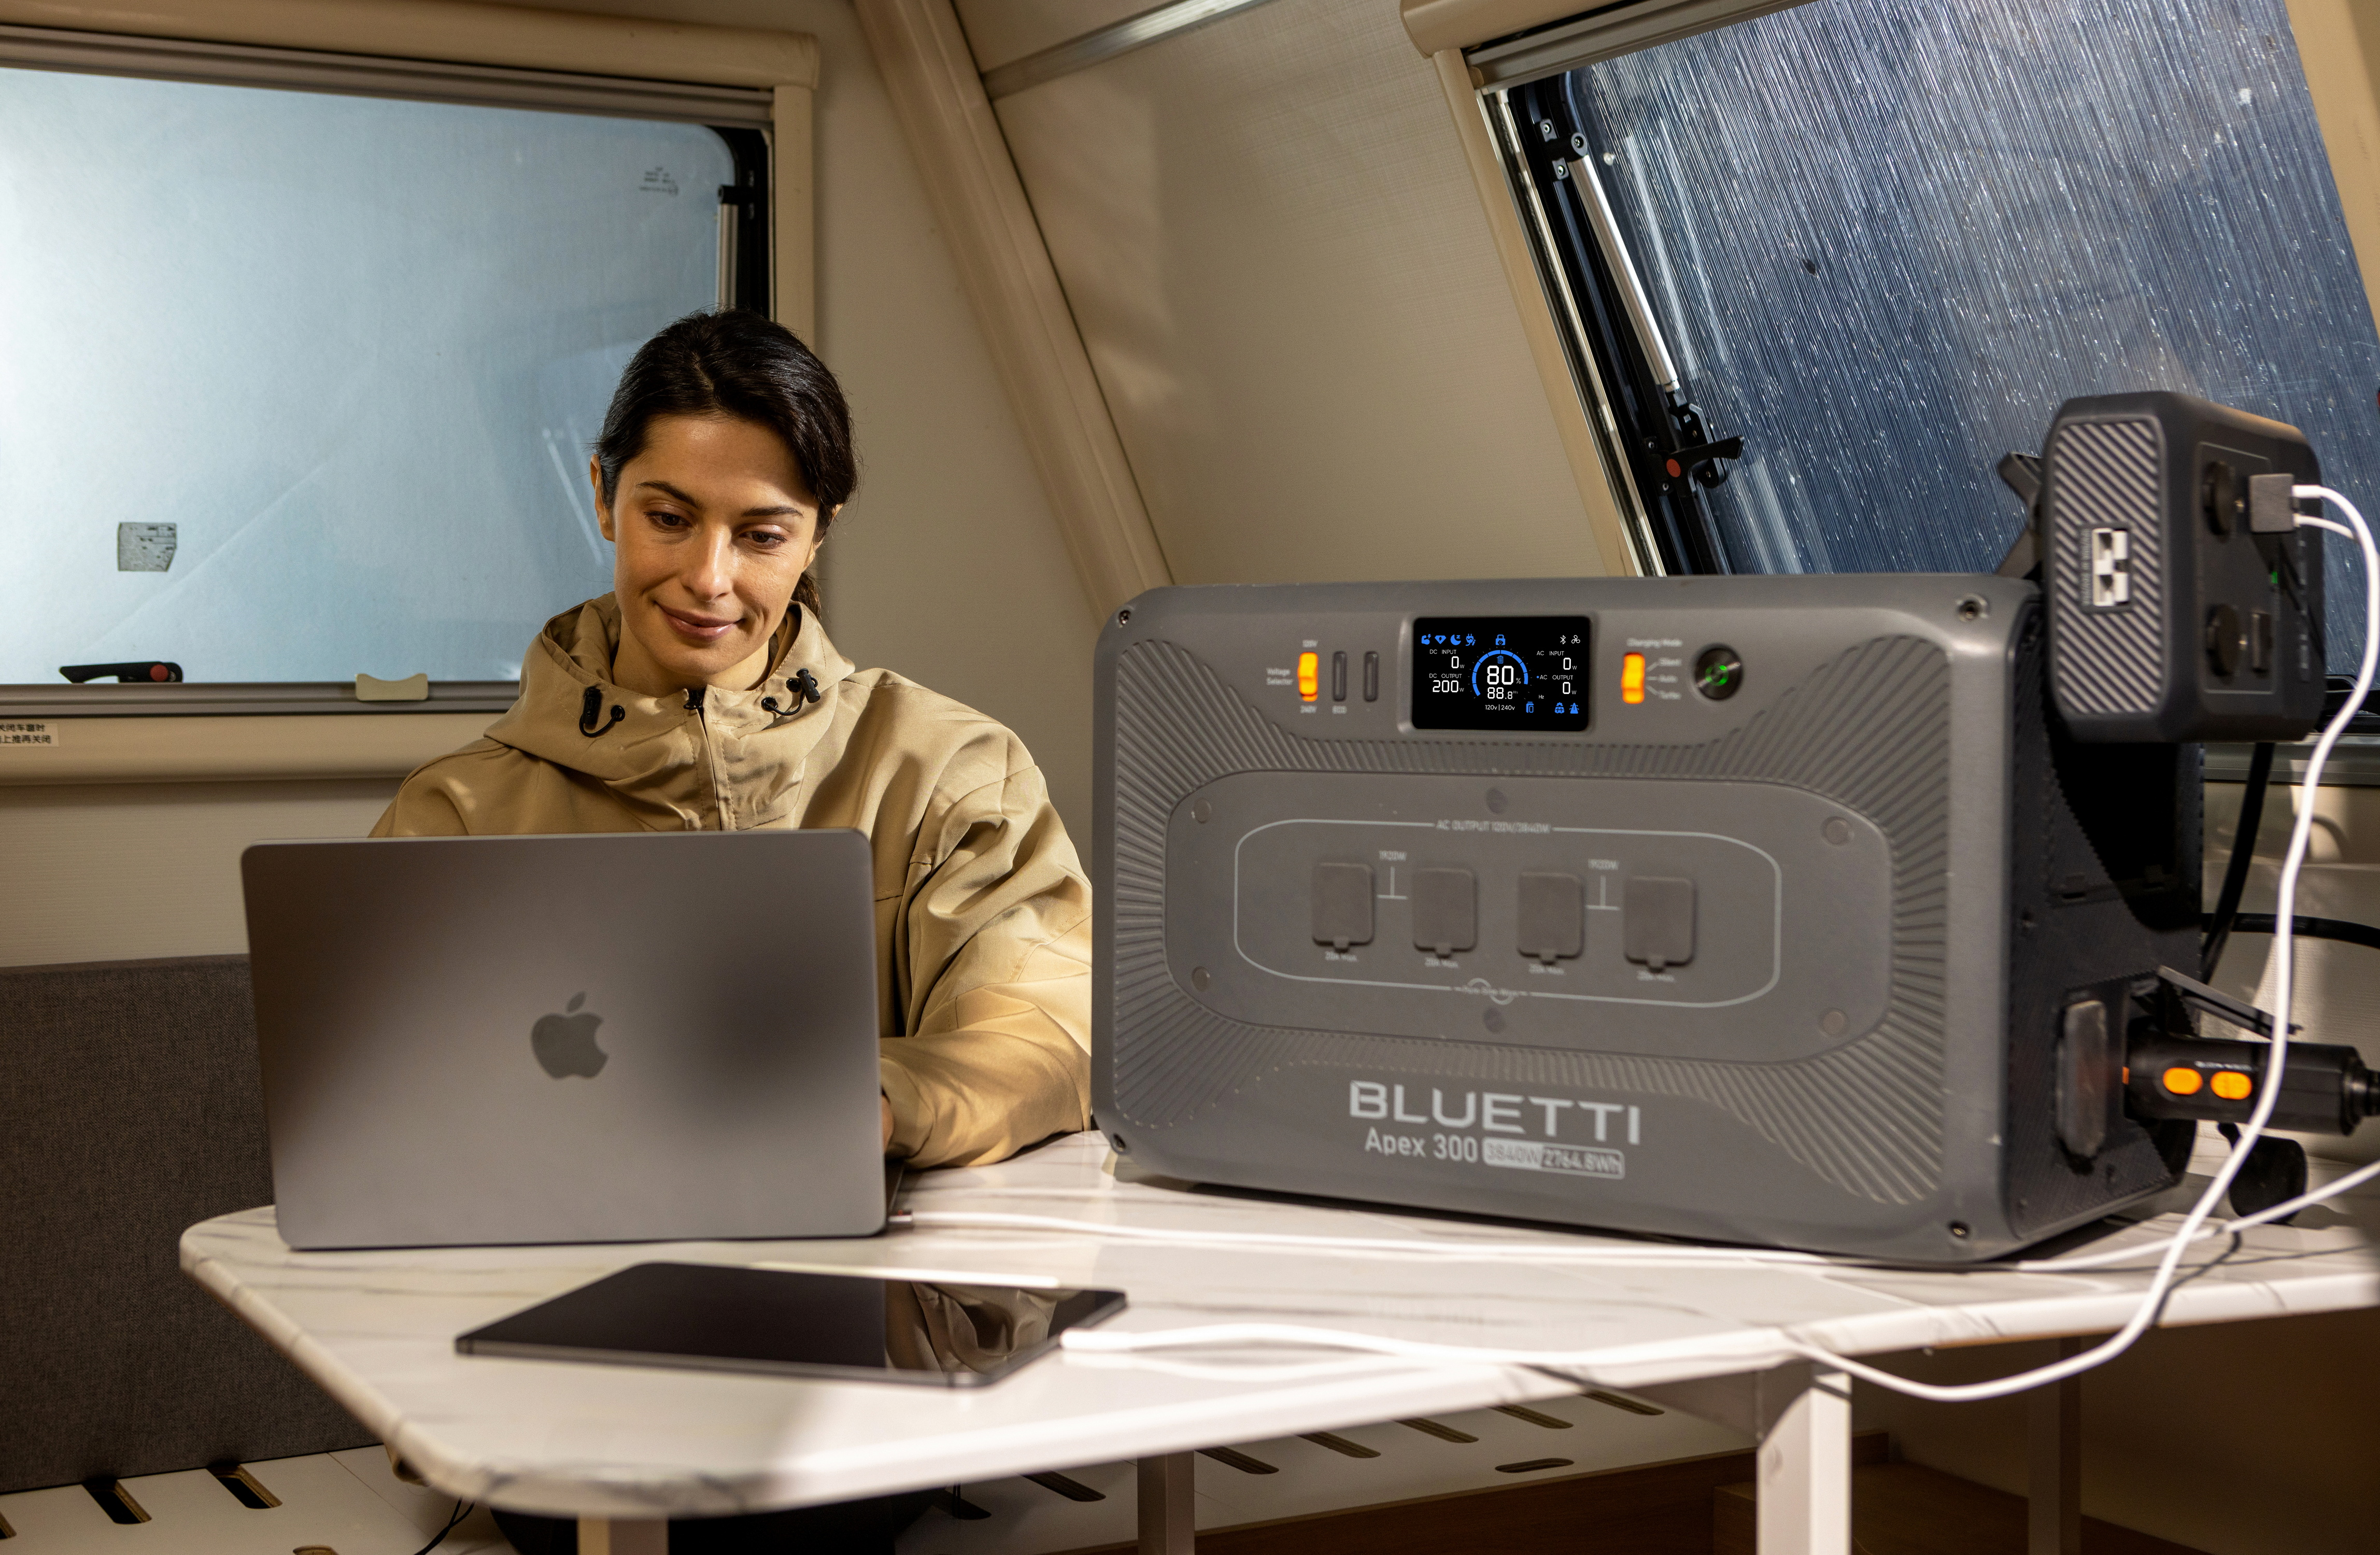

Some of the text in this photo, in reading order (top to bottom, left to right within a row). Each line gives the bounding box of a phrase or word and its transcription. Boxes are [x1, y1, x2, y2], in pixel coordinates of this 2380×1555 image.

[1436, 819, 1451, 830] AC
[1452, 820, 1490, 831] OUTPUT
[1349, 1080, 1641, 1145] BLUETTI
[1365, 1126, 1426, 1158] Apex
[1433, 1133, 1479, 1164] 300
